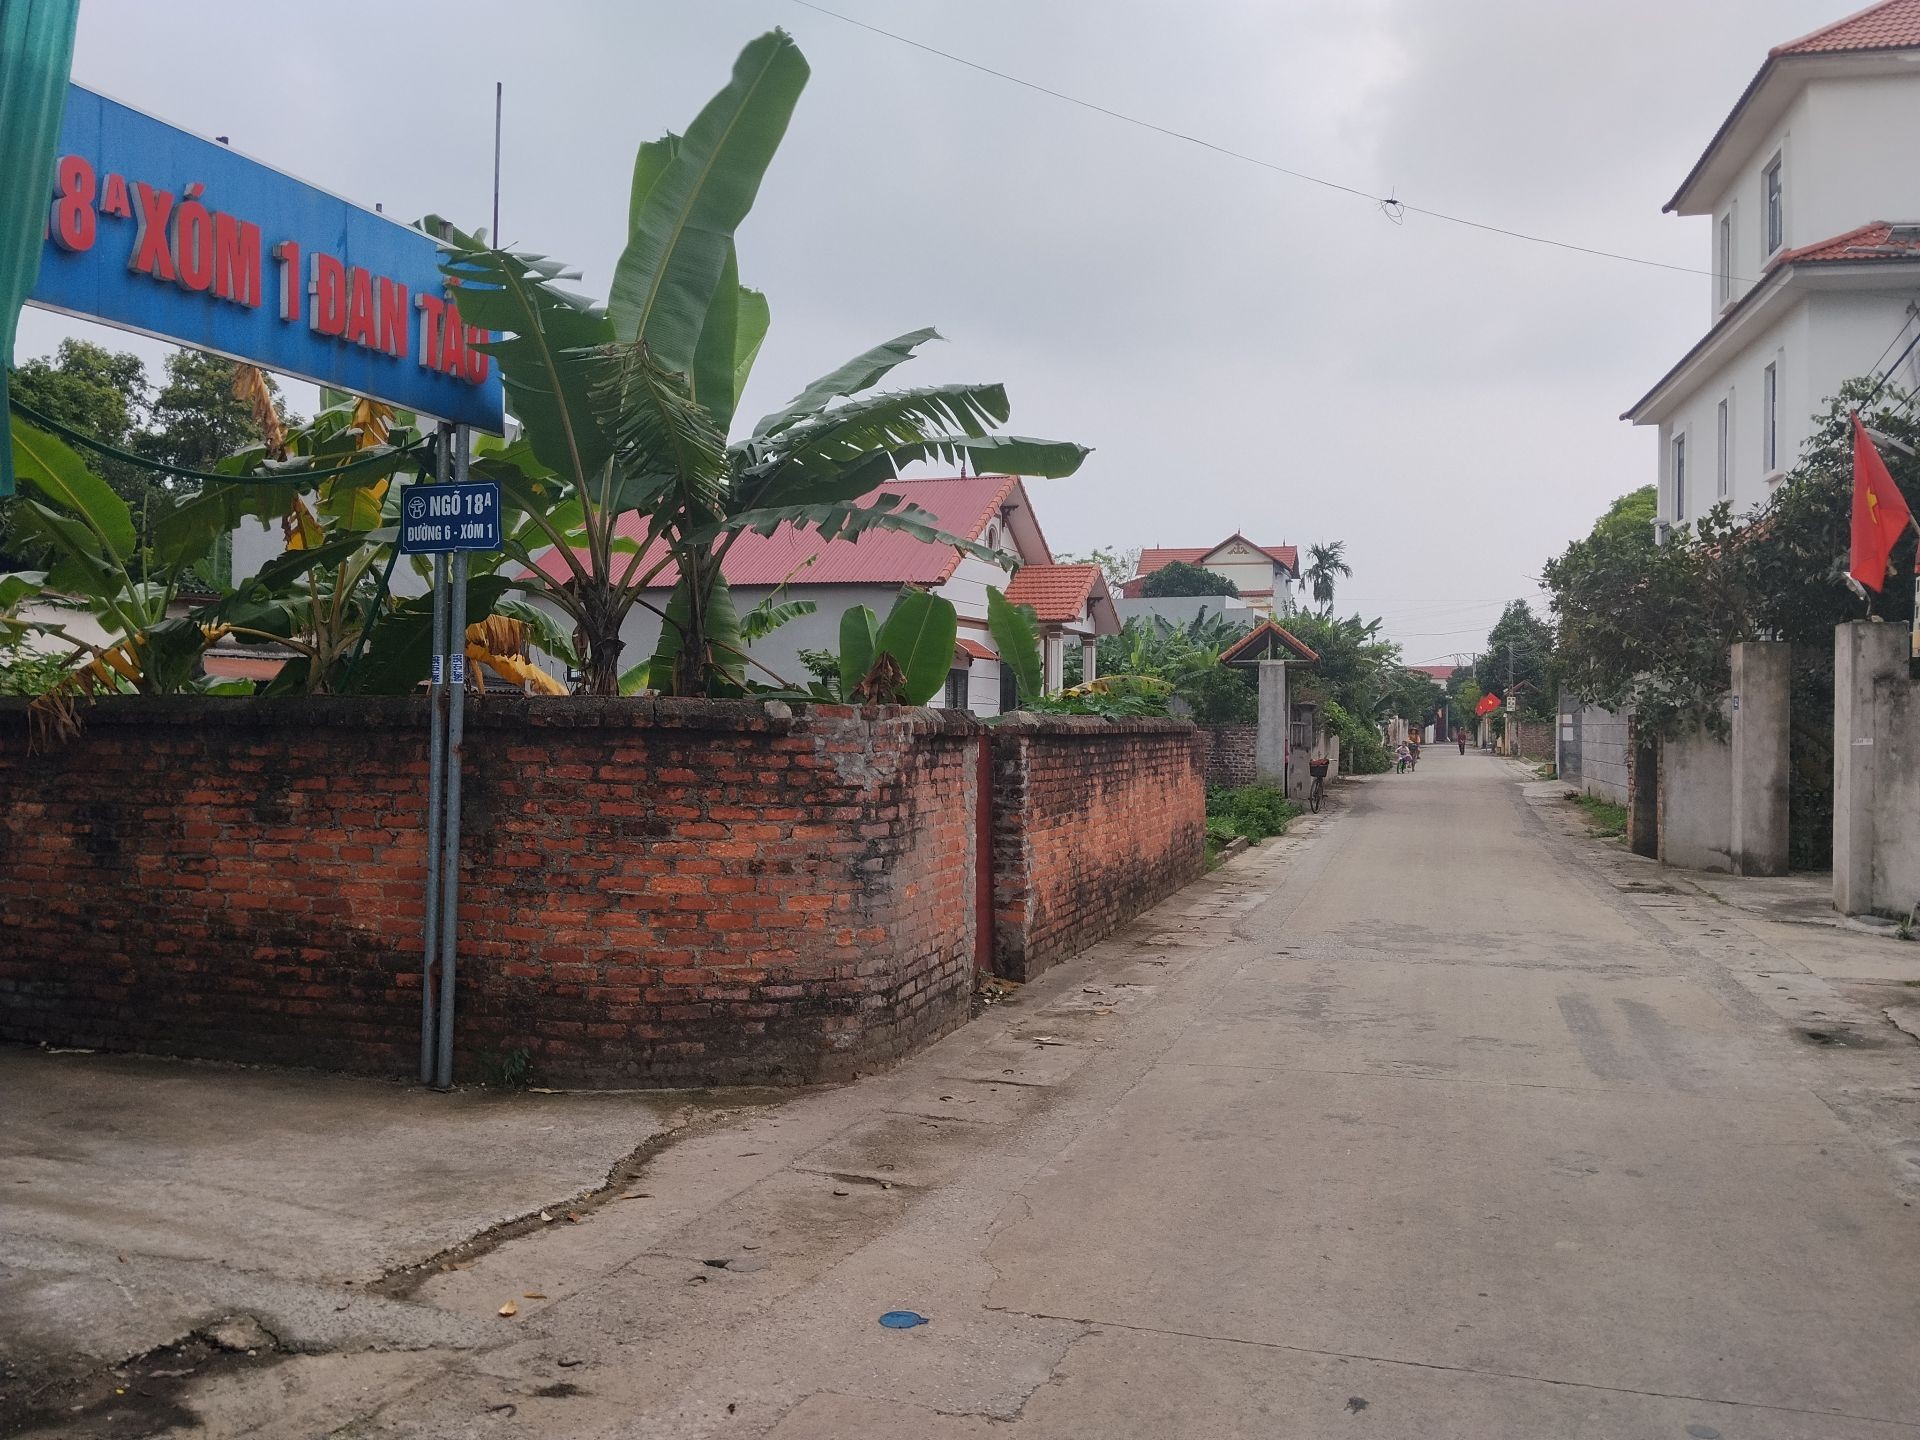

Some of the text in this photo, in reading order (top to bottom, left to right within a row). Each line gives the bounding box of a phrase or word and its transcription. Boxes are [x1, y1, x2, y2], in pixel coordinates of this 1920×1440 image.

[44, 154, 132, 251] 8A
[127, 182, 262, 309] XÓM
[272, 241, 300, 322] 1
[308, 252, 408, 358] ĐAN
[429, 490, 461, 517] NGÕ
[407, 522, 442, 542] ĐƯỜNG
[444, 525, 451, 540] 6
[460, 520, 484, 540] XÓM
[487, 523, 493, 539] 1
